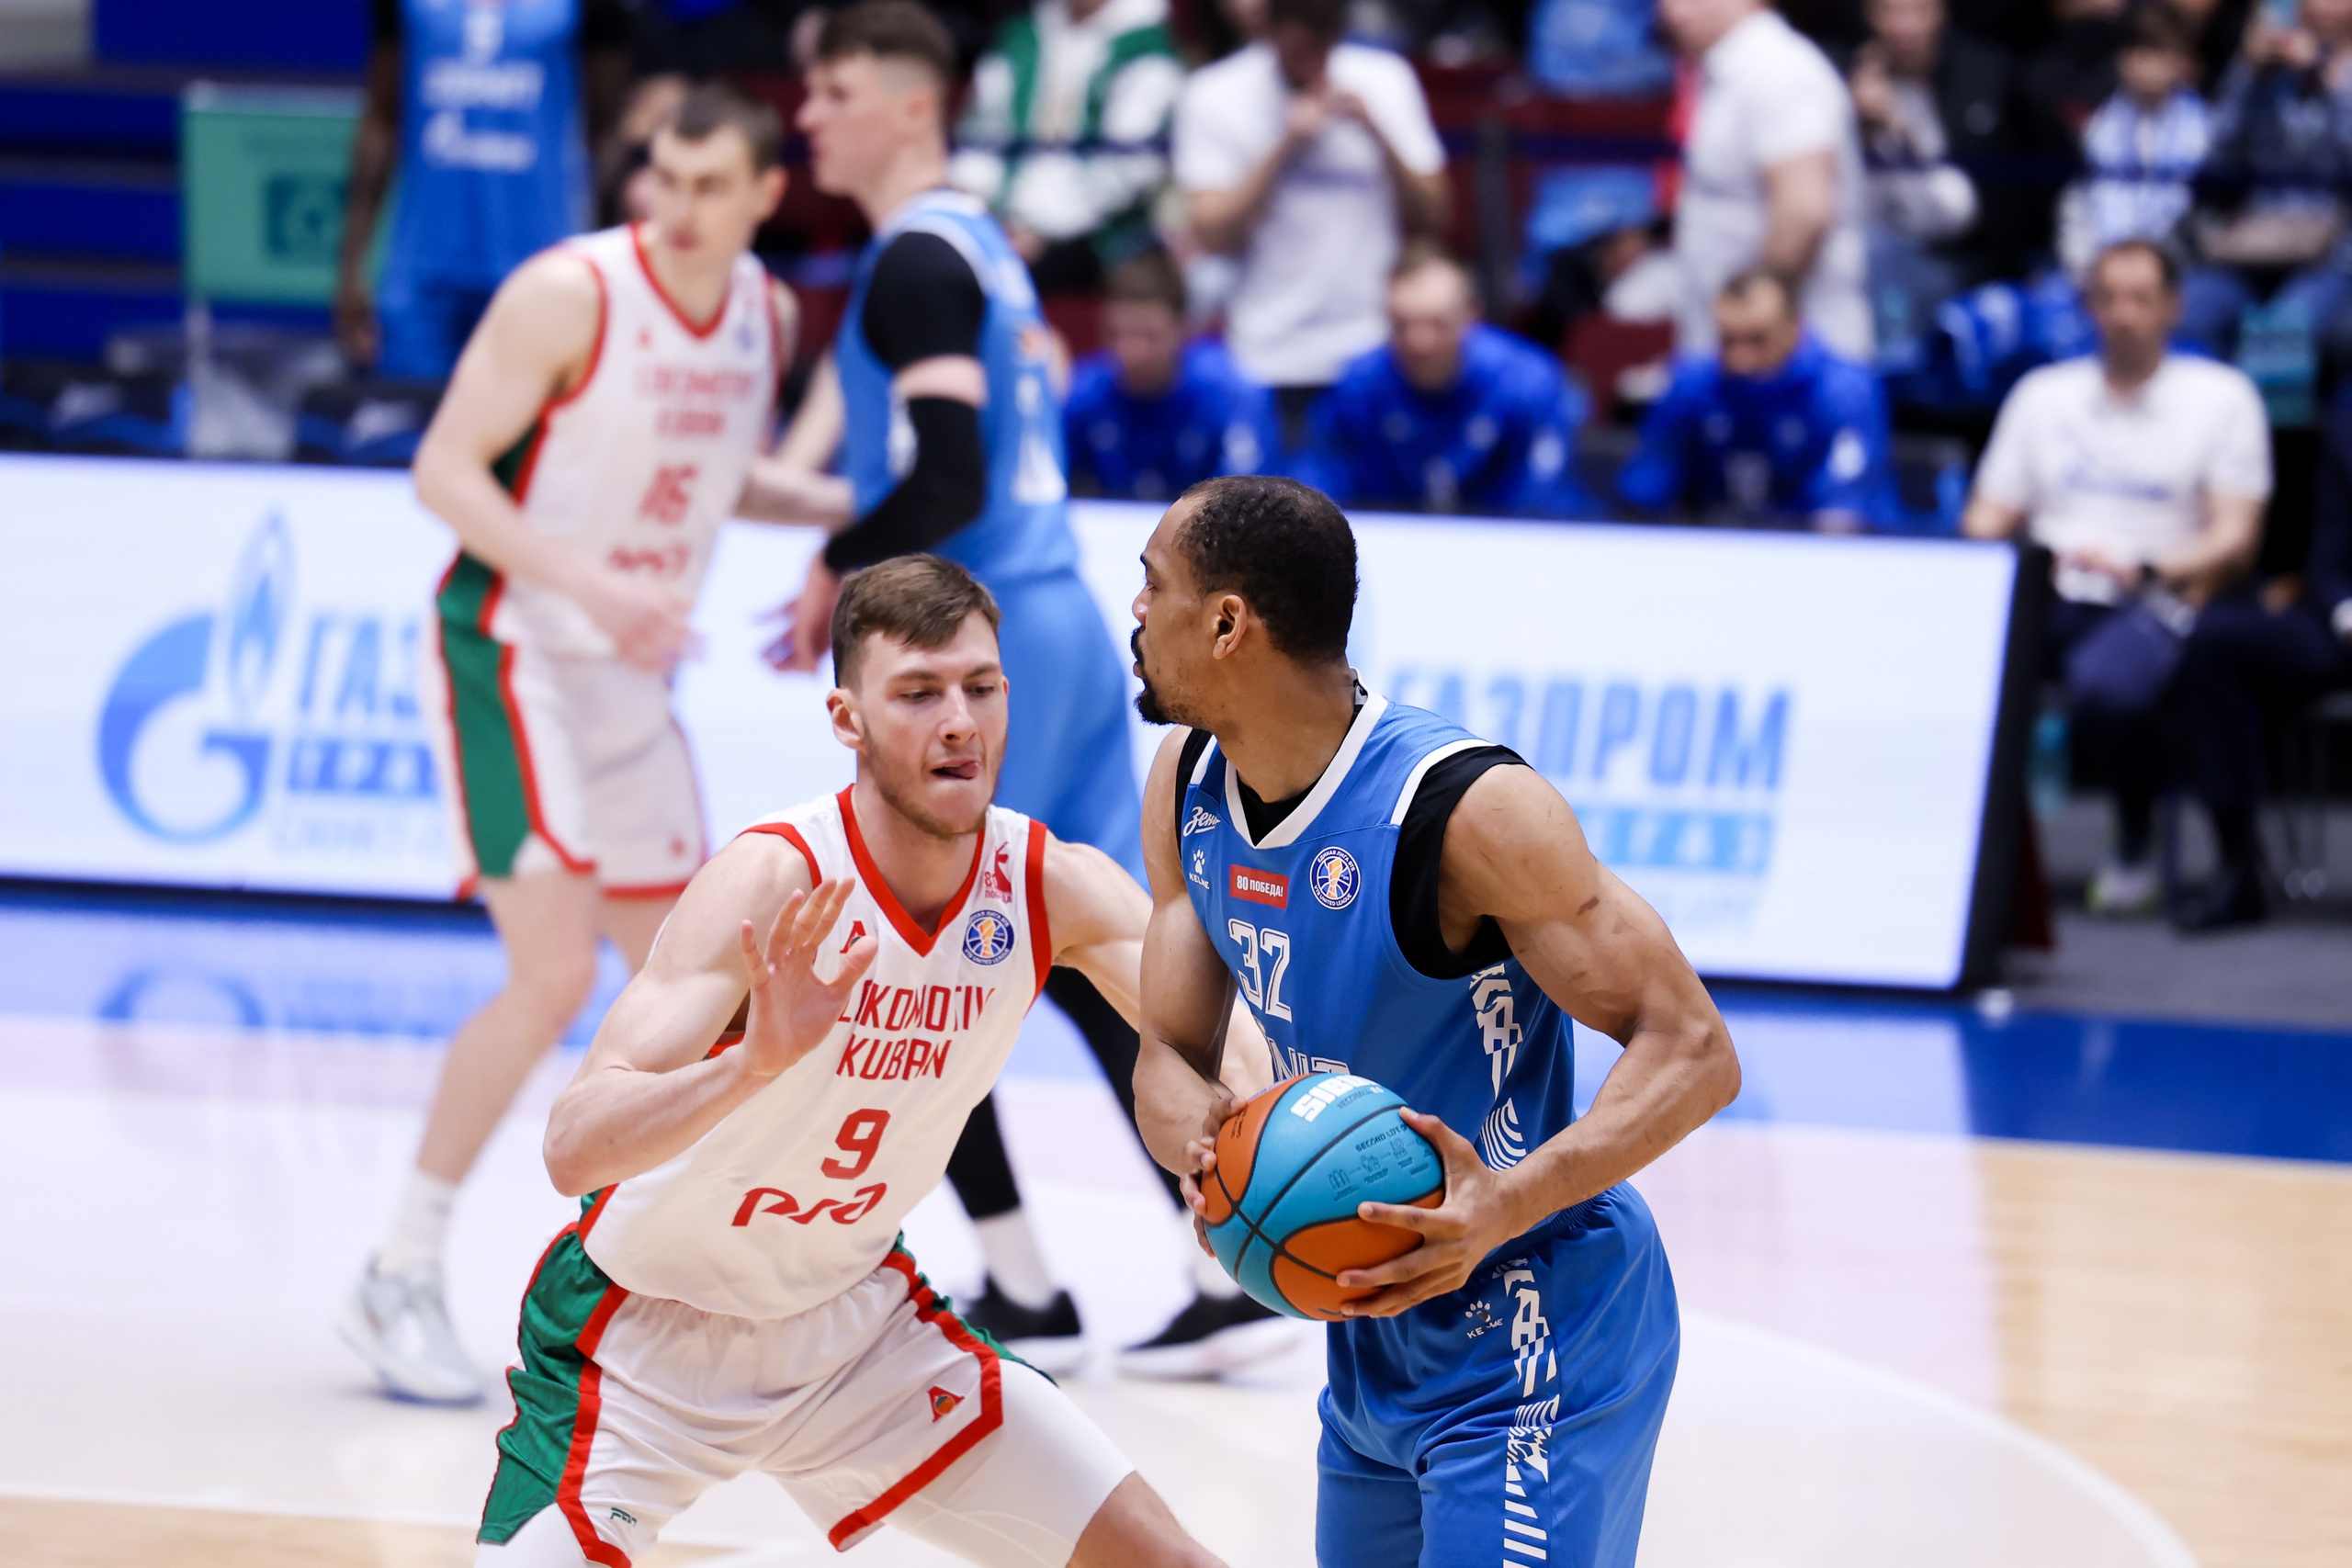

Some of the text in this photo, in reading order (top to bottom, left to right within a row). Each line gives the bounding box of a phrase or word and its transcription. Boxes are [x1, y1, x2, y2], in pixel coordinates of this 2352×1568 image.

[1236, 874, 1284, 897] 80 ПОБЕДА!
[1319, 892, 1337, 907] UNITED
[1336, 892, 1352, 907] LEAGUE
[1227, 918, 1293, 1023] 32
[836, 1033, 953, 1082] KUBAN
[820, 1108, 891, 1180] 9
[1355, 1133, 1386, 1153] SECOND
